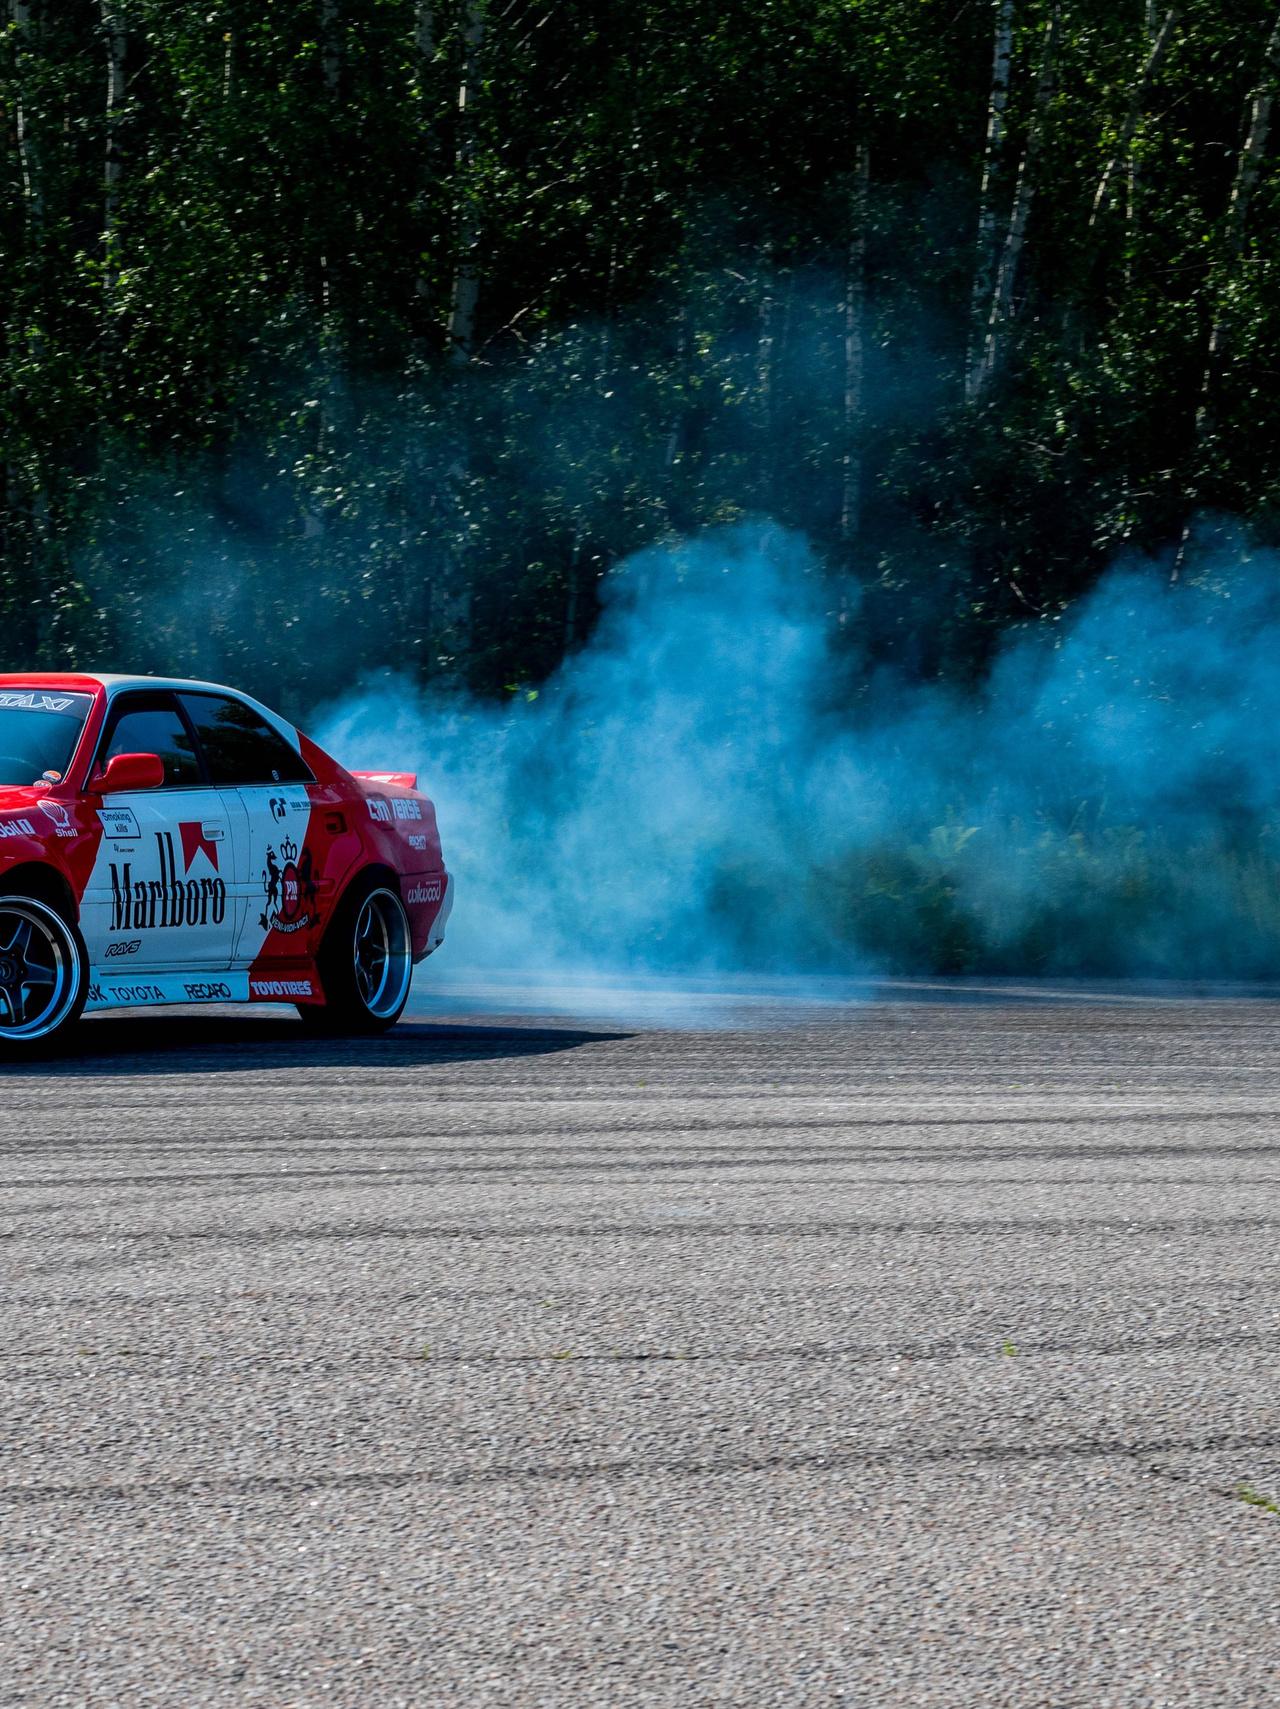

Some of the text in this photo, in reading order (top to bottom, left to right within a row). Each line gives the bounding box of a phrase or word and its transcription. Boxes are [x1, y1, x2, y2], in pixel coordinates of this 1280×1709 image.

[102, 811, 132, 823] Smoking
[55, 828, 78, 838] Shell
[114, 823, 128, 833] kills
[108, 832, 227, 931] Marlboro
[285, 880, 298, 901] PM
[105, 940, 141, 957] RAYS
[87, 983, 108, 1002] GK
[108, 985, 166, 1001] TOYOTA
[183, 982, 231, 999] RECARO
[250, 981, 312, 995] TOYO TIRES
